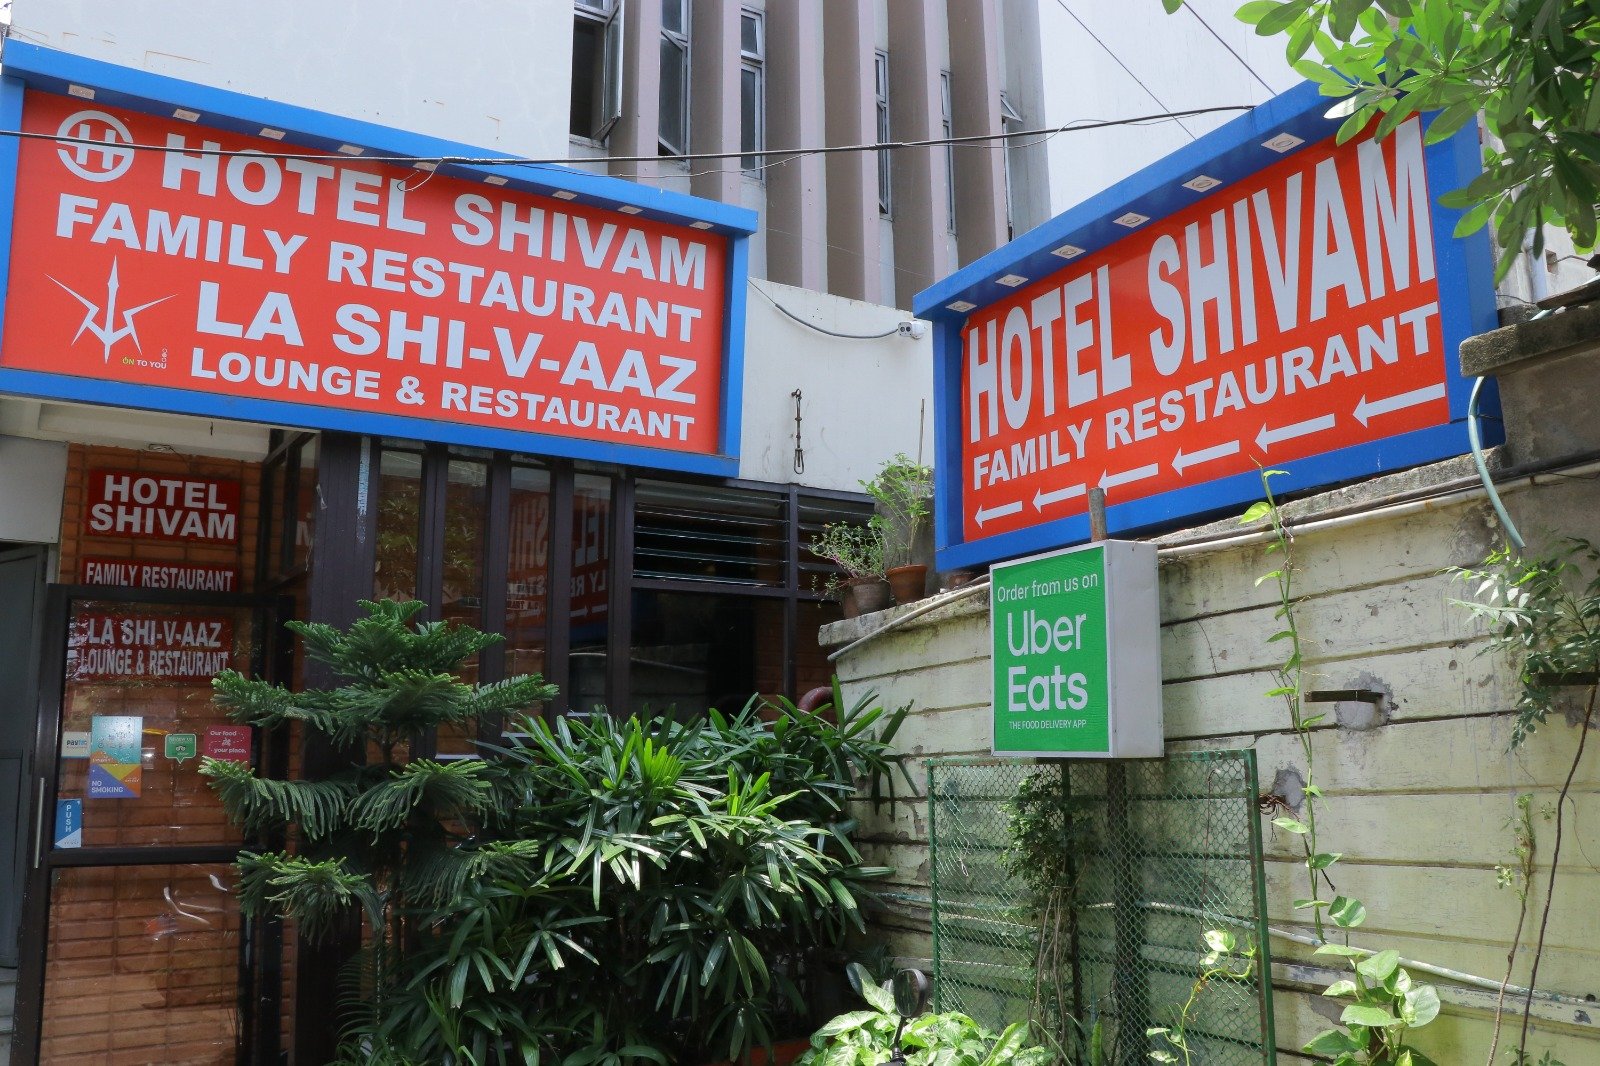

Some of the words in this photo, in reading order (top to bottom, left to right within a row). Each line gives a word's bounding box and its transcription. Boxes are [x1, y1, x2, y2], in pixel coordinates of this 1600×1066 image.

[162, 133, 427, 235] HOTEL
[451, 193, 707, 290] SHIVAM
[56, 193, 308, 275] FAMILY
[327, 241, 702, 343] RESTAURANT
[969, 264, 1132, 443] HOTEL
[1147, 116, 1436, 376] SHIVAM
[196, 281, 304, 347] LA
[332, 303, 697, 404] SHI-V-AAZ
[137, 359, 148, 367] TO
[149, 361, 167, 370] YOU
[190, 347, 381, 400] LOUNGE
[395, 375, 426, 406] &
[441, 381, 695, 441] RESTAURANT
[973, 418, 1105, 490] FAMILY
[1105, 301, 1439, 450] RESTAURANT
[104, 474, 227, 511] HOTEL
[90, 503, 236, 540] SHIVAM
[86, 562, 138, 586] FAMILY
[141, 566, 234, 592] RESTAURANT
[997, 583, 1029, 602] Order
[1031, 579, 1061, 598] from
[1064, 577, 1079, 592] us
[1082, 573, 1098, 588] on
[88, 618, 115, 644] LA
[121, 619, 222, 647] SHI-V-AAZ
[1007, 609, 1087, 657] Uber
[80, 648, 132, 675] LOUNGE
[136, 650, 145, 675] &
[150, 651, 229, 676] RESTAURANT
[1008, 665, 1088, 712] Eats
[1009, 720, 1021, 730] THE
[1022, 720, 1040, 729] FOOD
[1040, 719, 1072, 729] DELIVERY
[1072, 719, 1087, 729] APP
